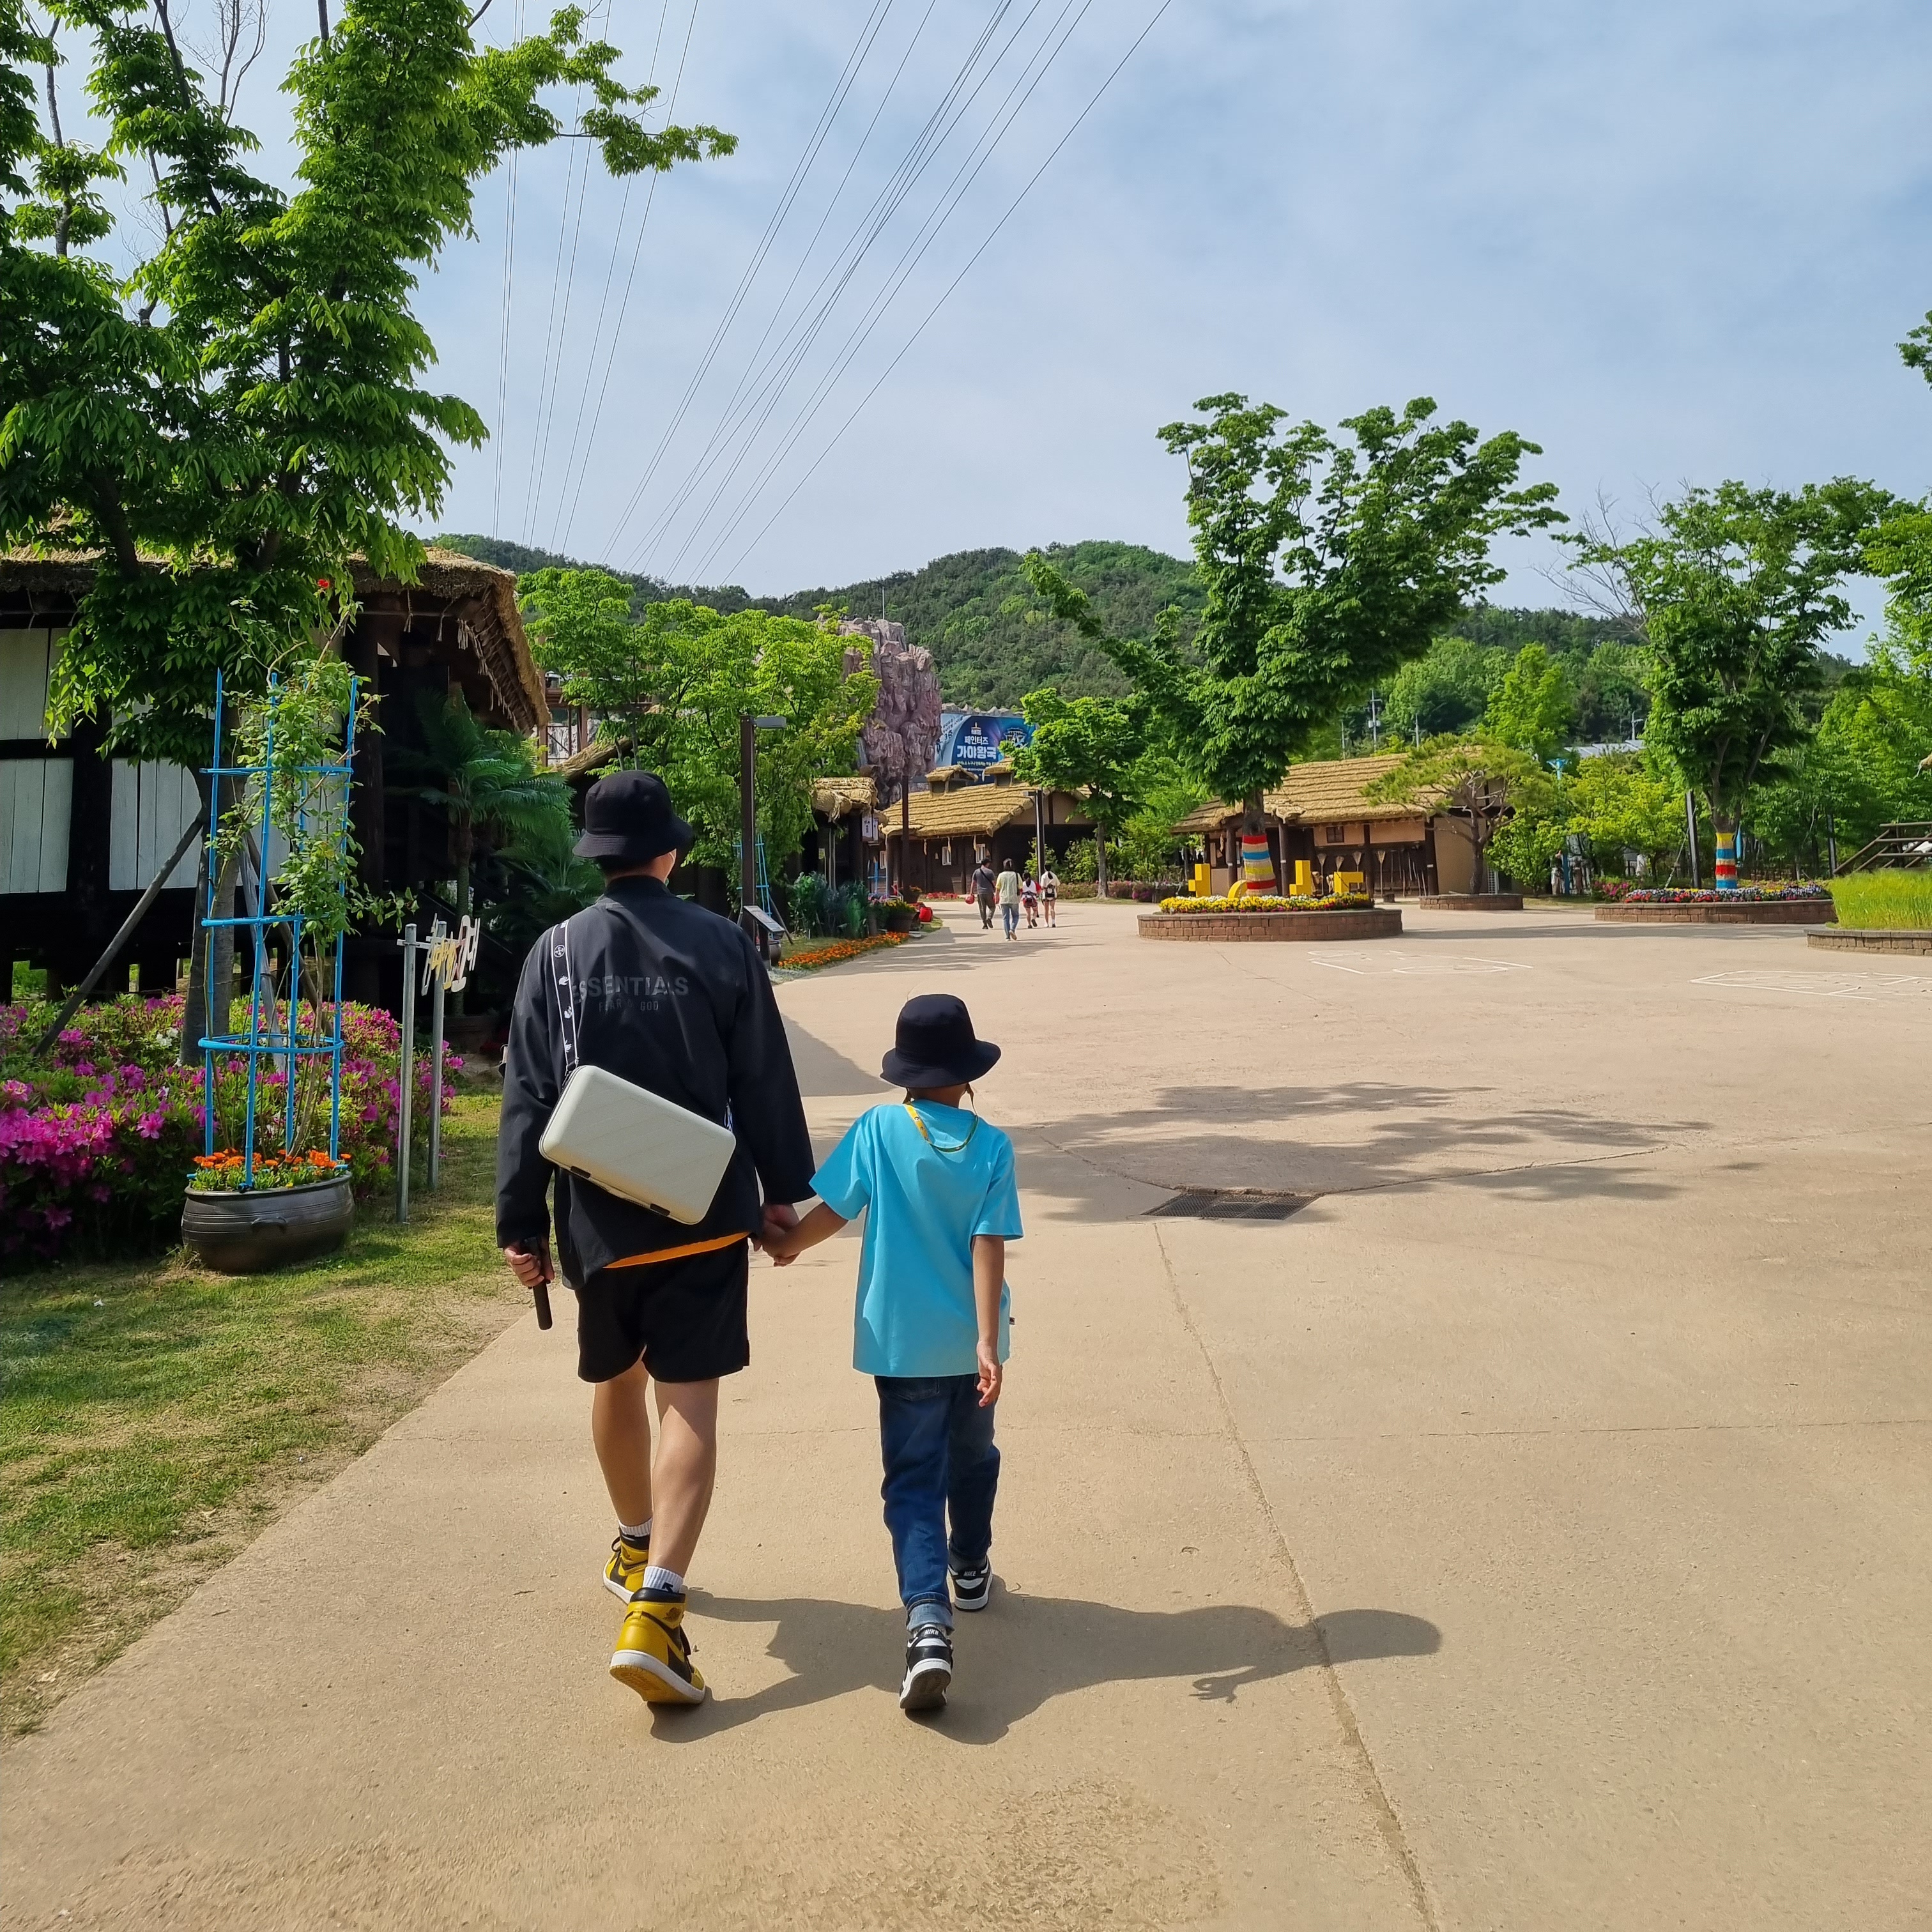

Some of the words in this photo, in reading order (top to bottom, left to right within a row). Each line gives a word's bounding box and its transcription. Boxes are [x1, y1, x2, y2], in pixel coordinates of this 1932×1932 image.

[964, 736, 988, 745] 페인터즈
[957, 746, 997, 760] 가야왕국
[640, 1000, 659, 1011] GOD
